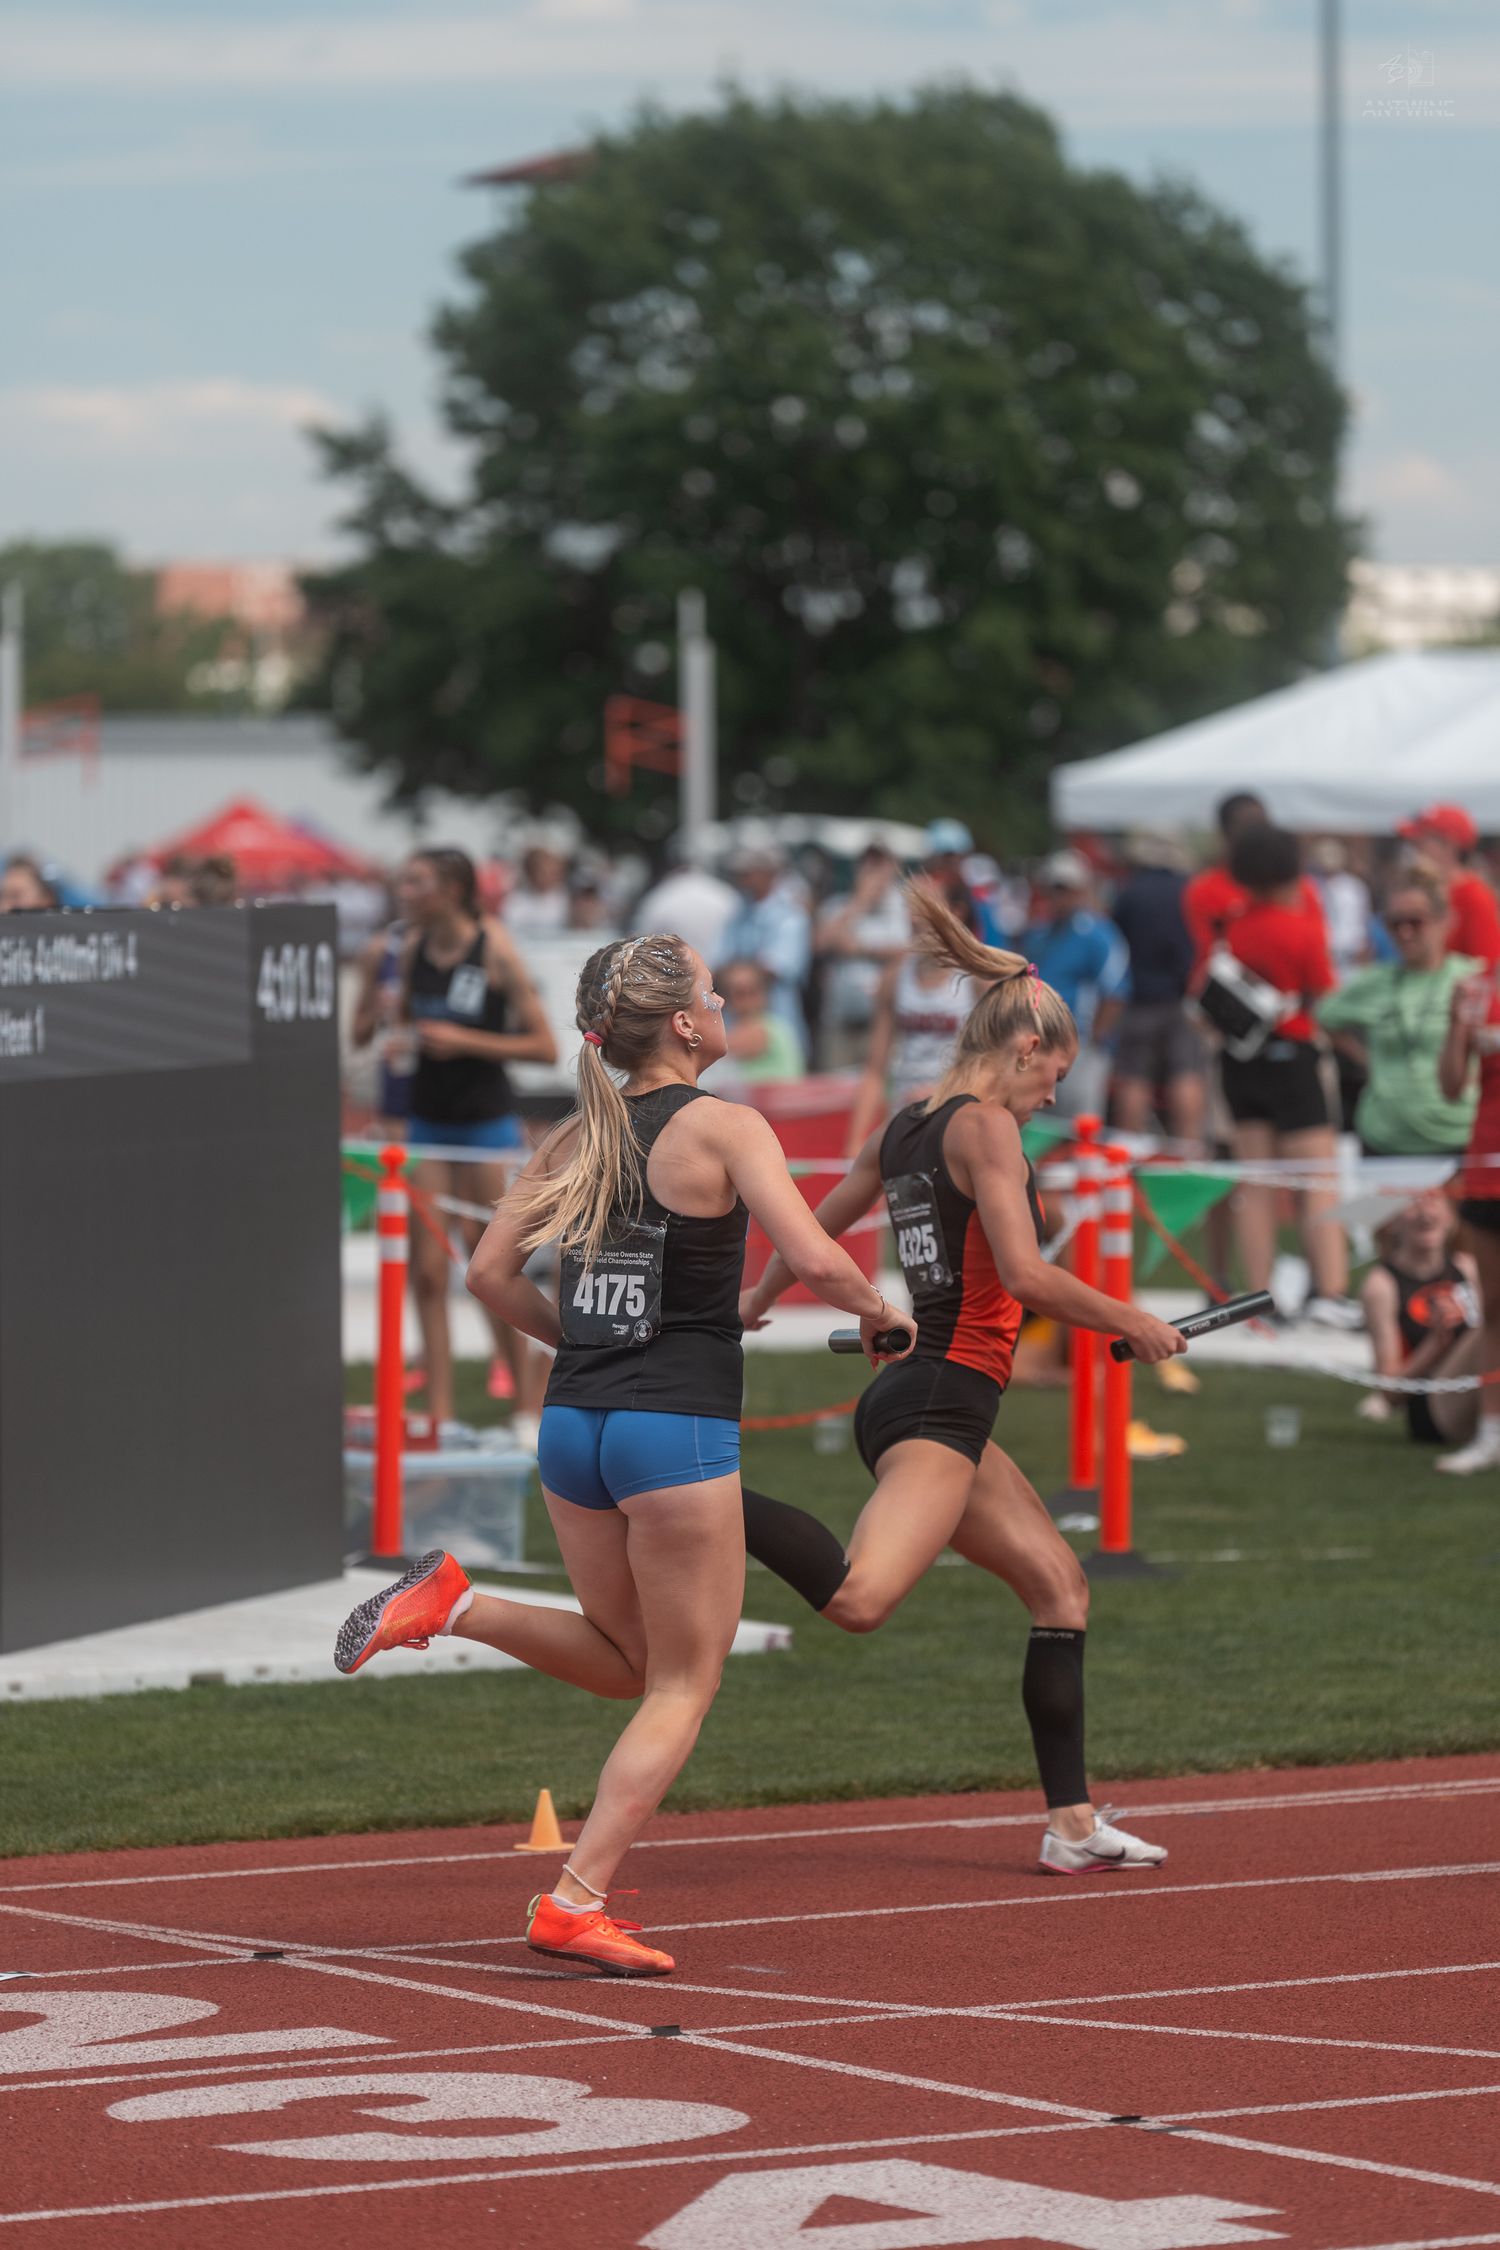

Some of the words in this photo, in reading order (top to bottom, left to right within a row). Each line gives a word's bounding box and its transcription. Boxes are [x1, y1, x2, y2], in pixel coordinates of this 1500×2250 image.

[604, 1250, 619, 1258] Jesse
[620, 1251, 639, 1259] Owens
[608, 1258, 650, 1266] Championships
[898, 1224, 937, 1267] 4325
[573, 1273, 646, 1317] 4175
[0, 1991, 397, 2074] 2
[106, 2071, 751, 2162] 3
[636, 2158, 1291, 2250] 4
